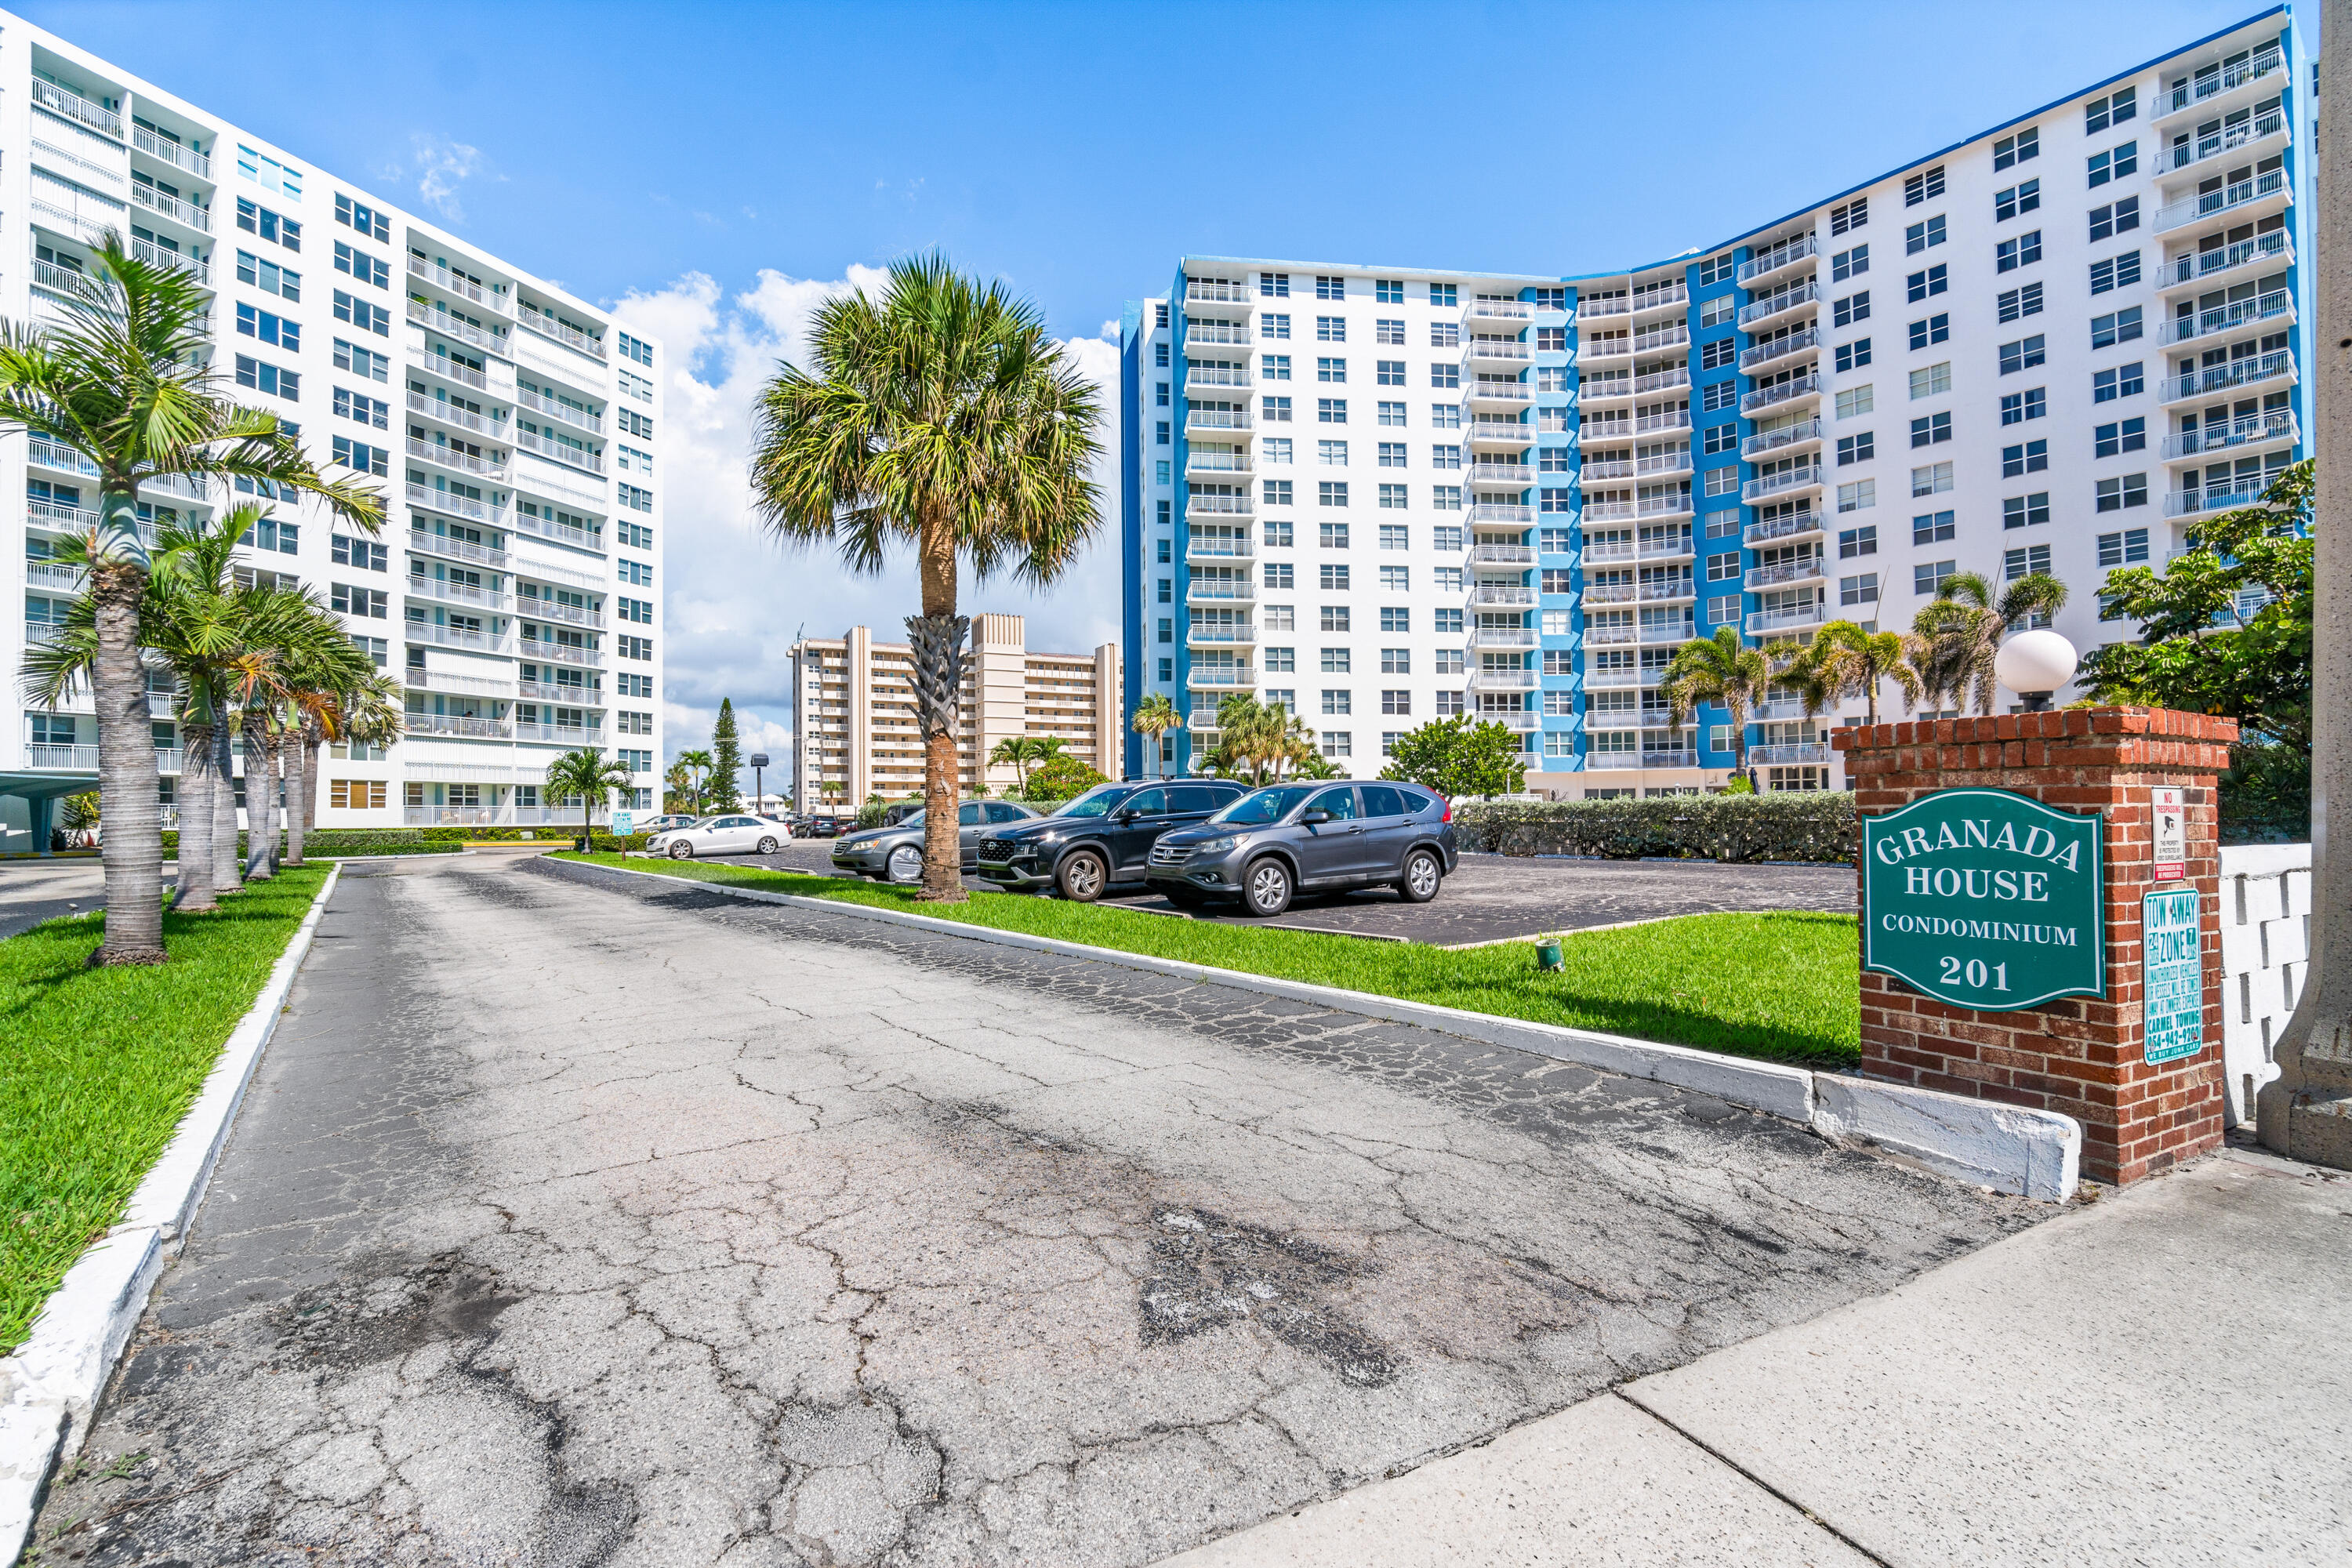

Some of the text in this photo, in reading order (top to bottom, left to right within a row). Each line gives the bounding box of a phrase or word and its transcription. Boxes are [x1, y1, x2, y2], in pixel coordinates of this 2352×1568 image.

[2155, 804, 2181, 814] TRESPASSING
[2164, 792, 2172, 804] NO
[1876, 819, 2080, 873] GRANADA
[1904, 866, 2049, 902] HOUSE
[2147, 895, 2196, 928] TOW AWAY
[1882, 913, 2078, 946] CONDOMINIUM
[2149, 933, 2158, 950] 24
[2188, 928, 2194, 944] 7
[2160, 931, 2186, 963] ZONE
[1940, 956, 2012, 992] 201
[2148, 962, 2198, 984] UNAUTHORIZED VEHICLES
[2154, 982, 2170, 1000] VESSELS
[2171, 981, 2180, 996] WILL
[2181, 979, 2186, 994] BE
[2148, 1001, 2158, 1017] AWAY
[2183, 993, 2199, 1010] EXPENSE
[2148, 1010, 2199, 1035] CARMEL TOWING
